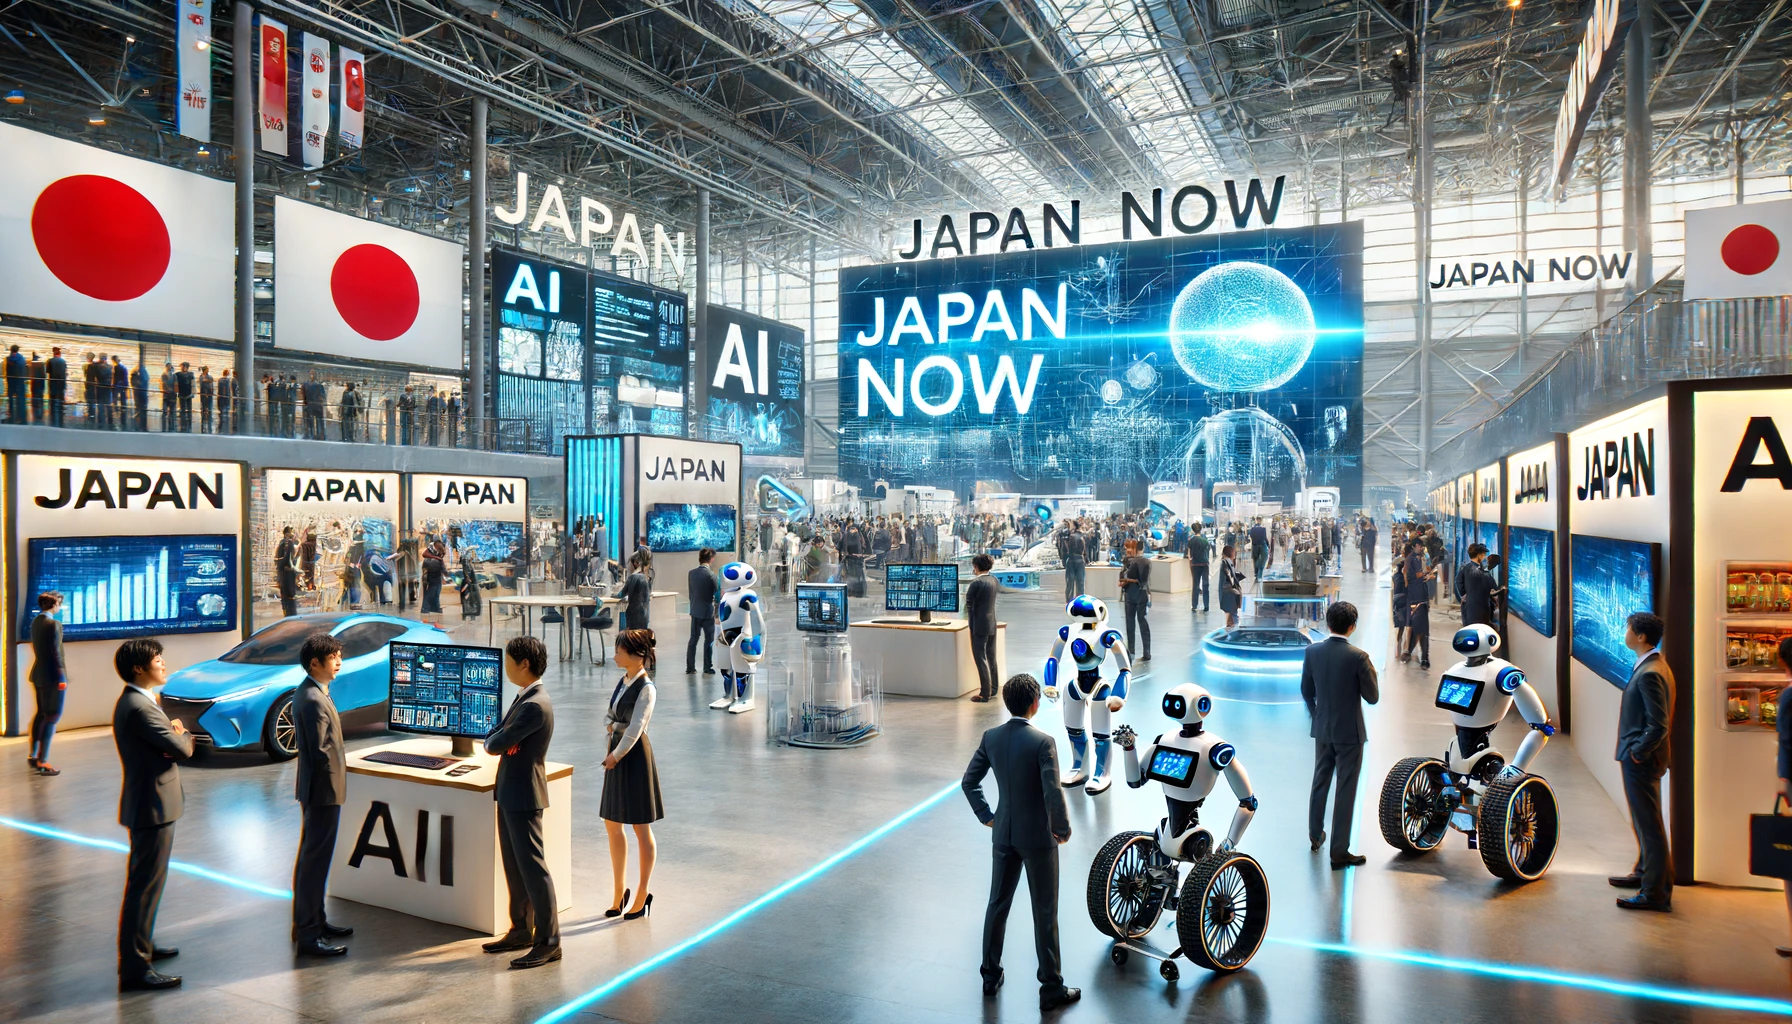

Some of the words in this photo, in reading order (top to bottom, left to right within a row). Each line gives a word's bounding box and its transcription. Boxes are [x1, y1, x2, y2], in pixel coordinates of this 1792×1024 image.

[494, 172, 685, 277] JAPAN
[900, 201, 1081, 259] JAPAN
[1121, 175, 1286, 239] NOW
[504, 263, 560, 313] AI
[1430, 259, 1534, 288] JAPAN
[1548, 252, 1632, 281] NOW
[856, 281, 1067, 348] JAPAN
[712, 322, 769, 396] AI
[857, 354, 1043, 417] NOW
[34, 468, 225, 510] JAPAN
[282, 477, 386, 503] JAPAN
[646, 457, 725, 482] JAPAN
[1577, 428, 1655, 501] JAPAN
[425, 481, 515, 505] JAPAN
